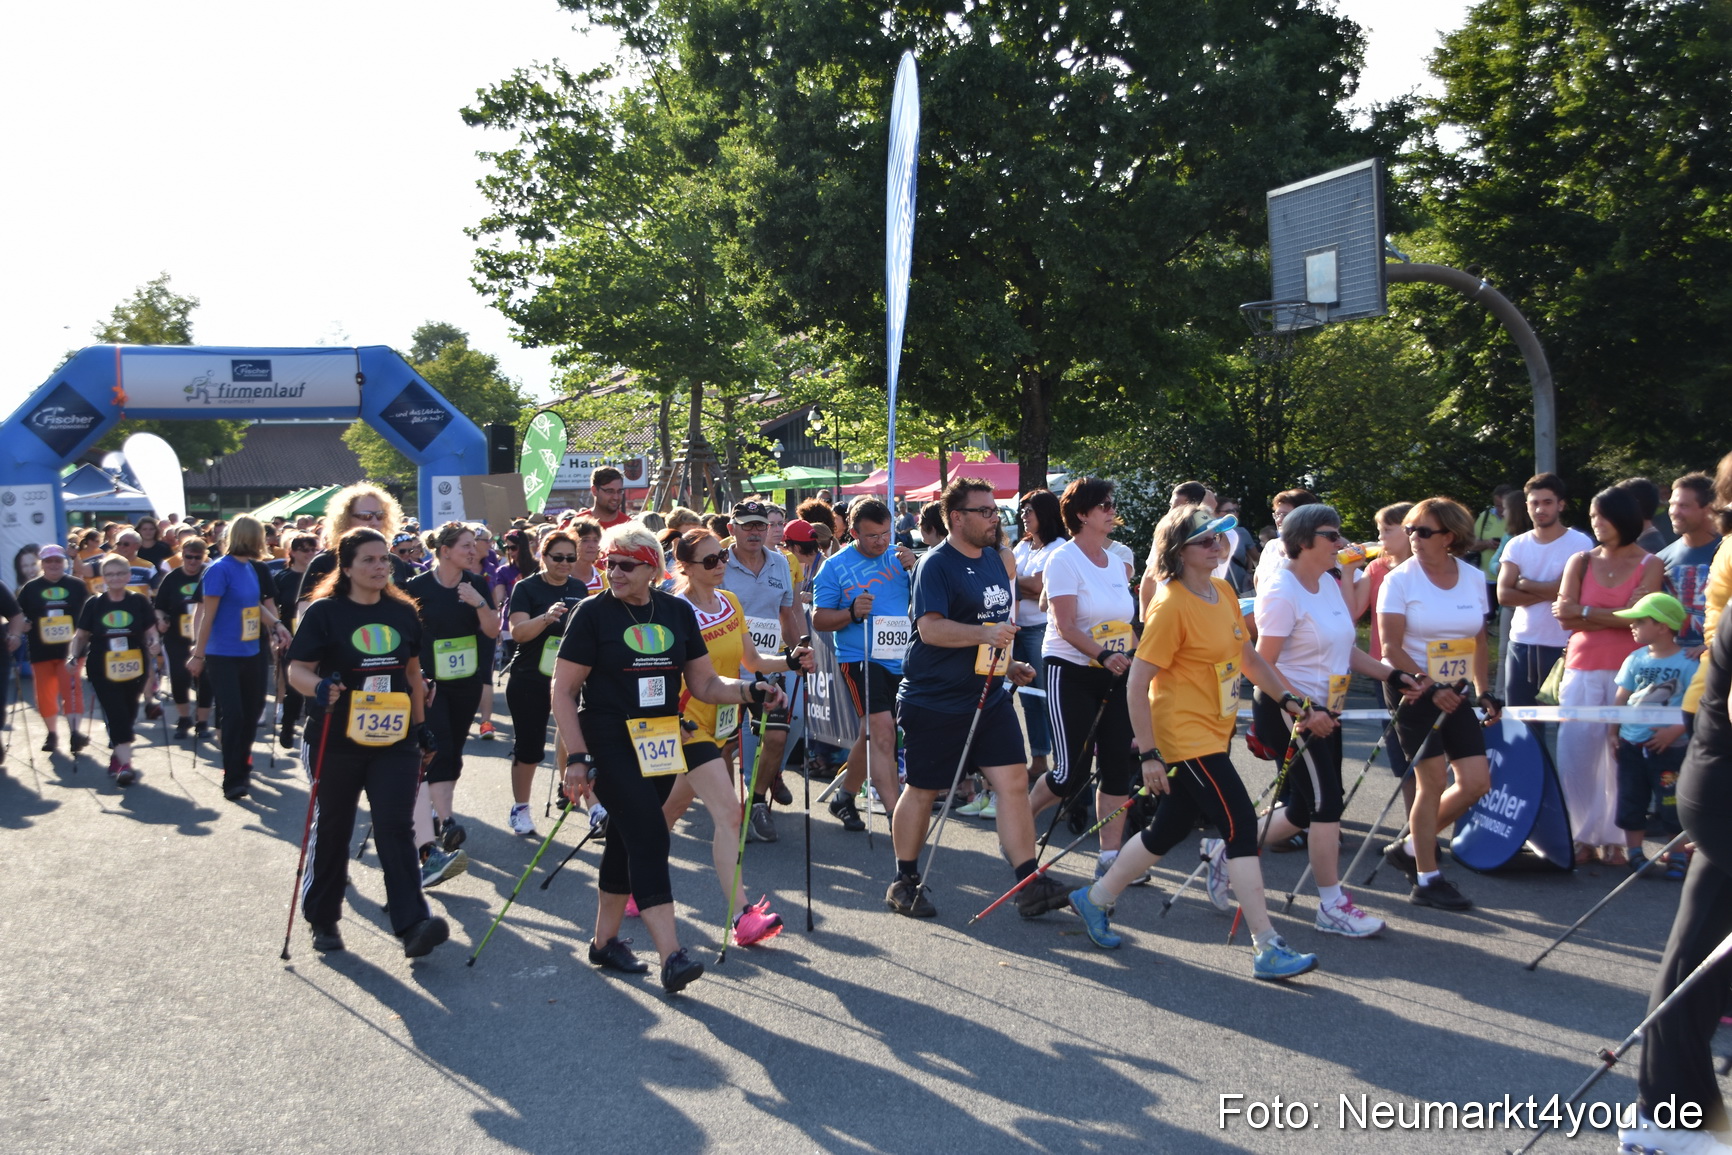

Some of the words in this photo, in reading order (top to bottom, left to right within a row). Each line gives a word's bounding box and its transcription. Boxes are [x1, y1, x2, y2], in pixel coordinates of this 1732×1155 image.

[218, 383, 306, 399] firmenlauf
[43, 414, 95, 424] Fischer
[876, 618, 907, 628] df-sports
[45, 626, 71, 637] 1351
[703, 628, 727, 642] MAX
[877, 631, 908, 646] 8939
[749, 631, 777, 648] 940
[111, 662, 141, 674] 1350
[449, 653, 466, 668] 91
[1439, 659, 1467, 676] 473
[357, 713, 404, 732] 1345
[719, 707, 734, 727] 913
[639, 739, 676, 760] 1347
